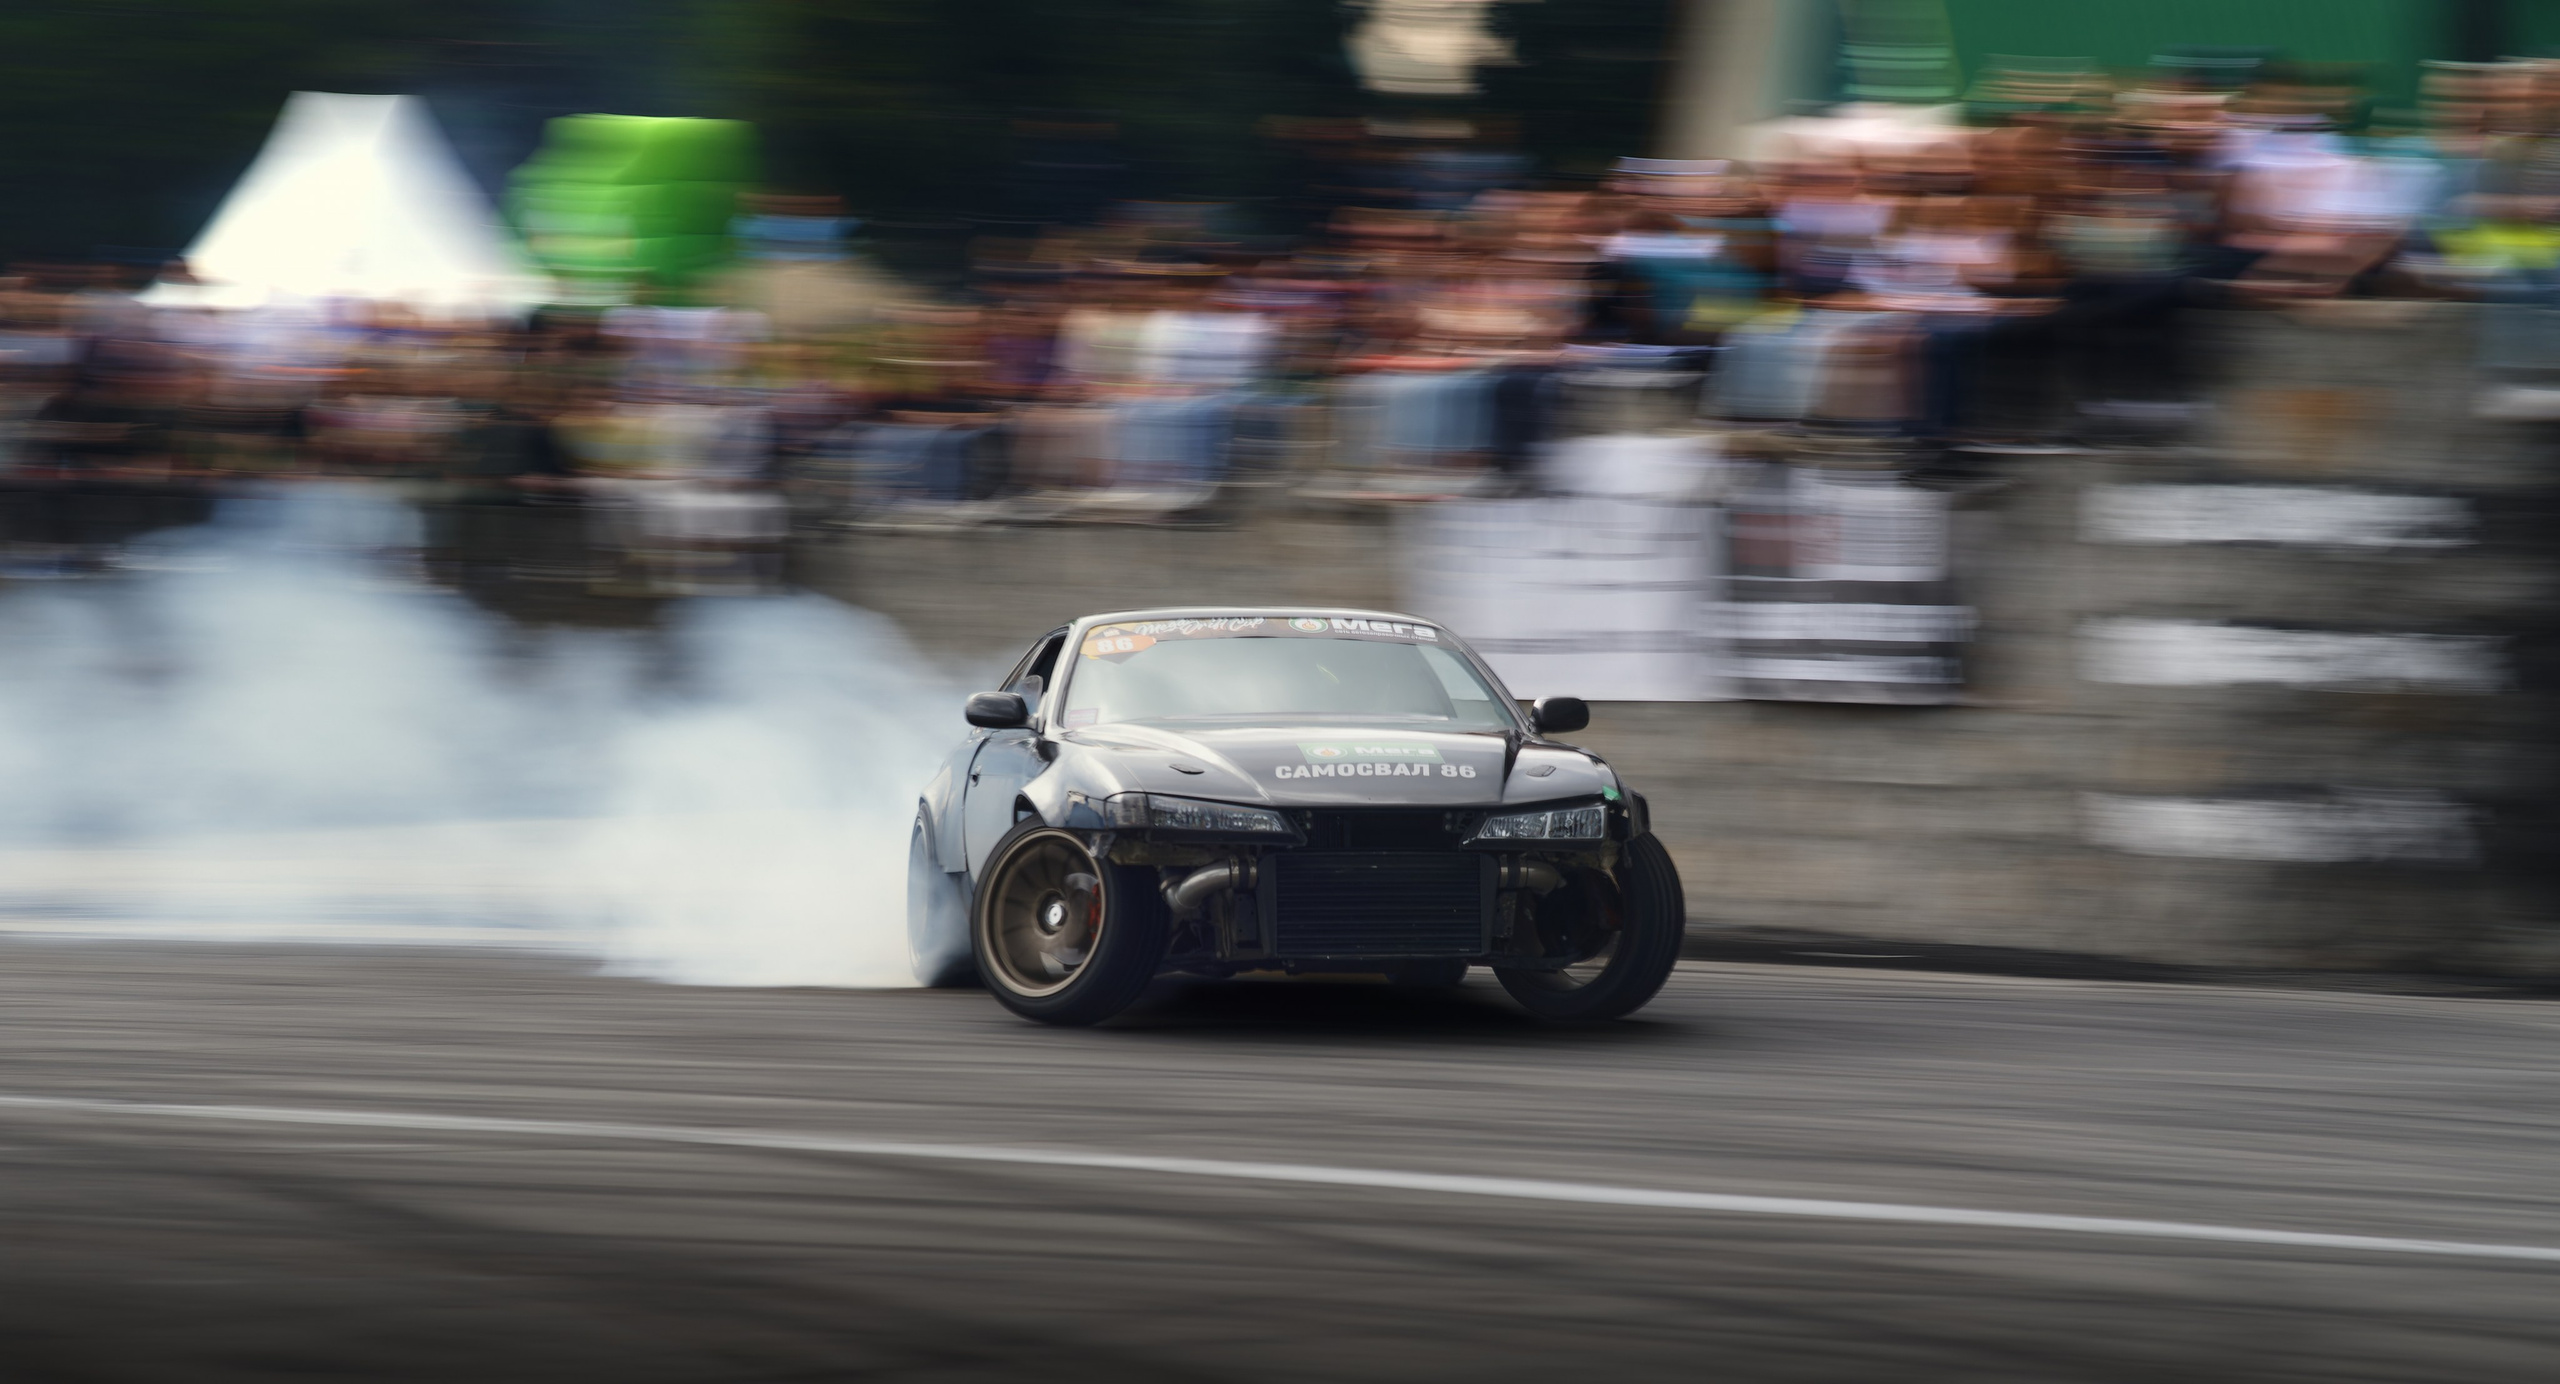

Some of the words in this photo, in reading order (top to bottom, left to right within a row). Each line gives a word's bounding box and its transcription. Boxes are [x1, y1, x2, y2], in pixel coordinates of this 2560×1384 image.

[1330, 618, 1436, 638] Мега
[1097, 637, 1134, 653] 86
[1354, 746, 1435, 755] Мега
[1275, 763, 1430, 779] САМОСВАЛ
[1440, 764, 1477, 778] 86
